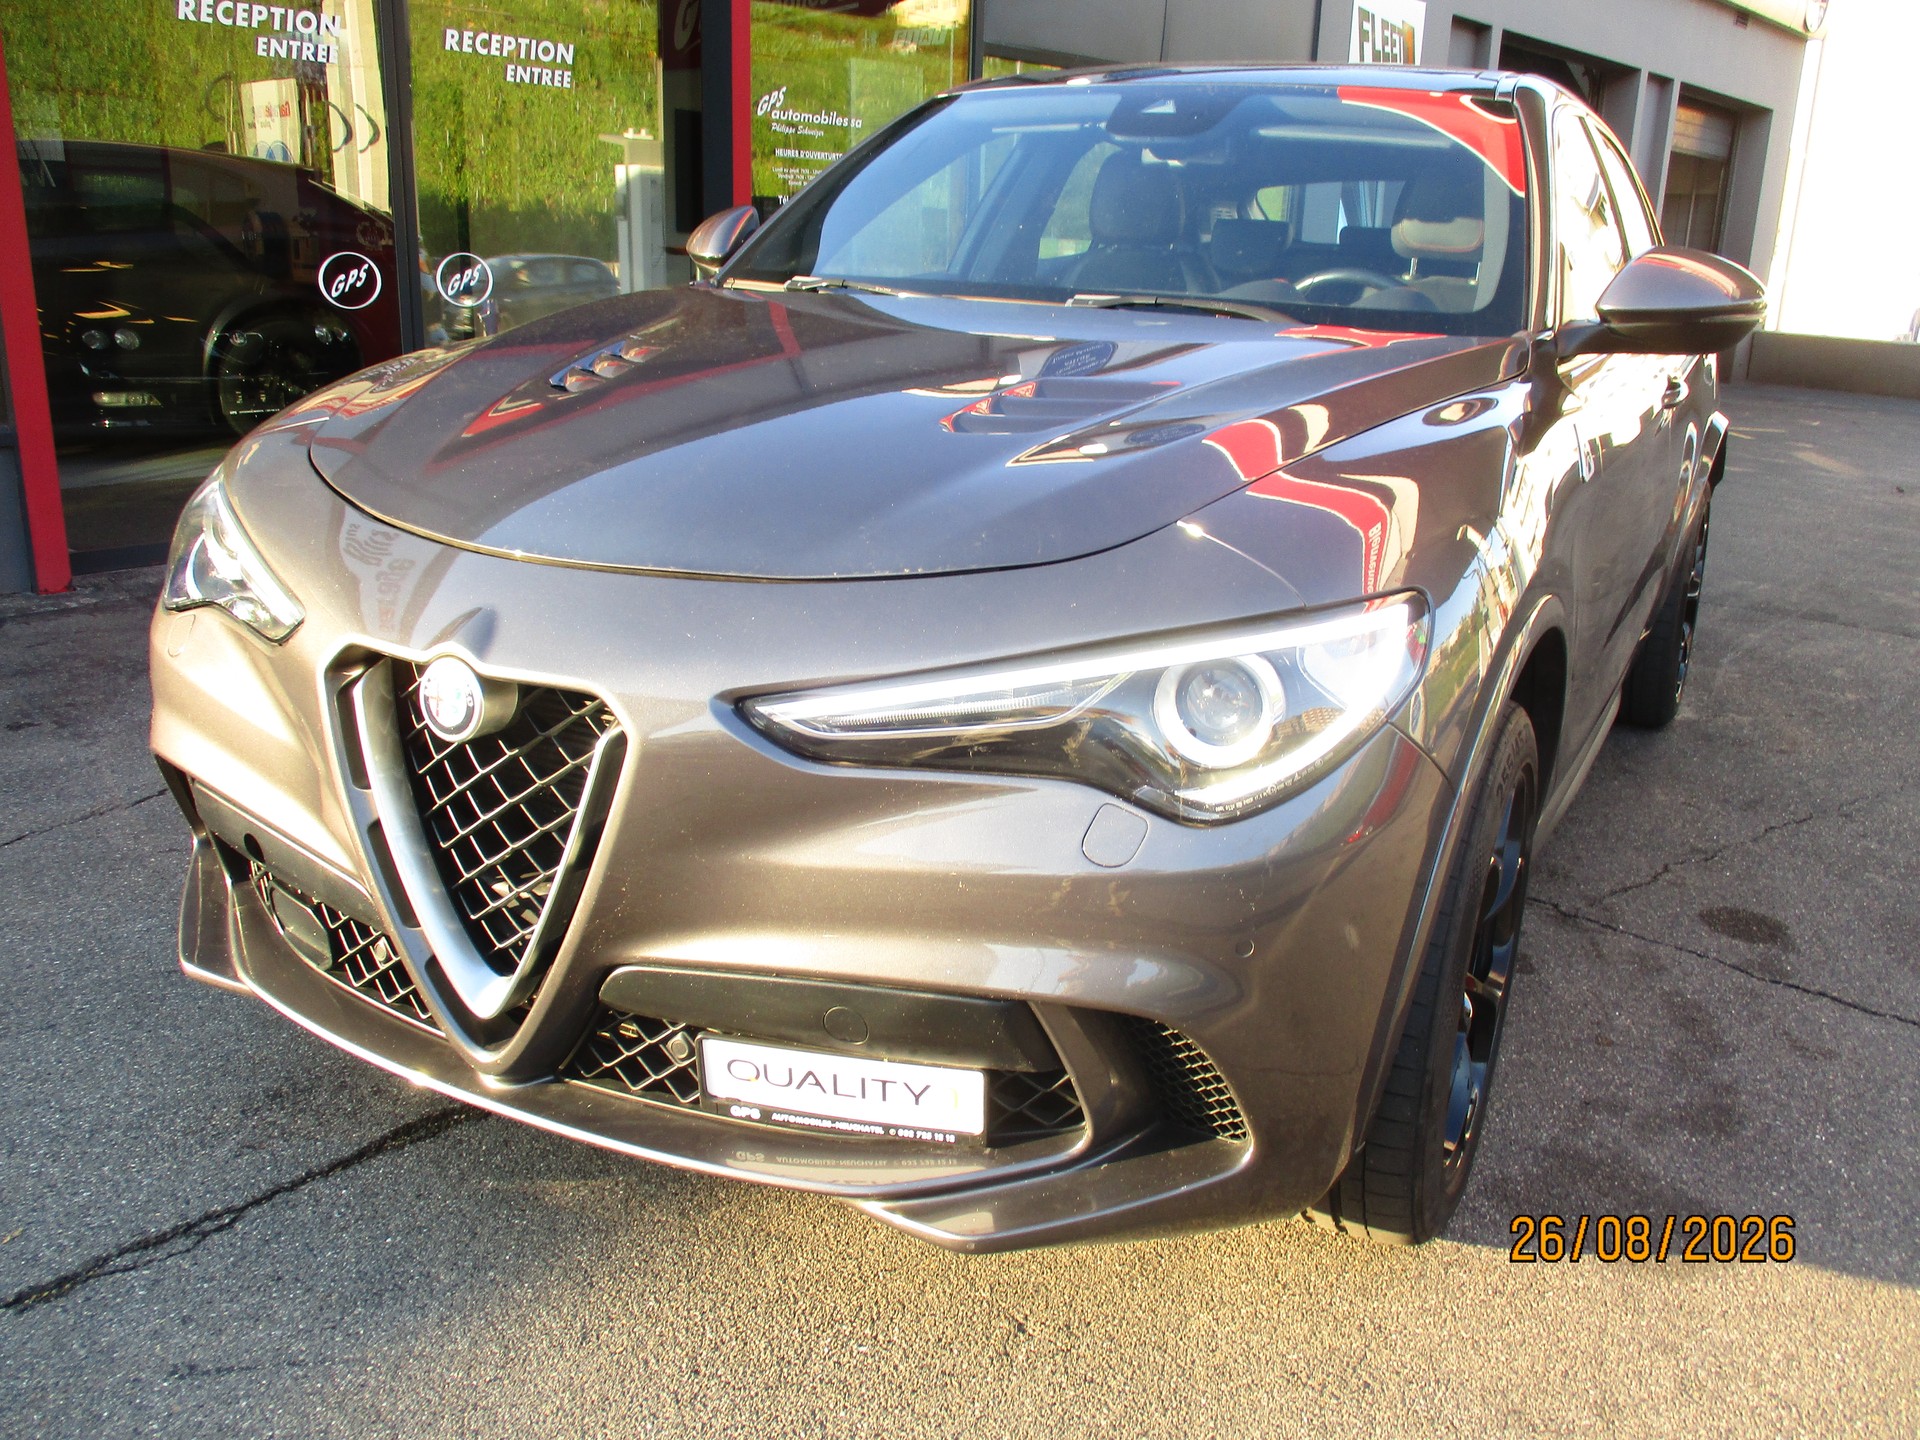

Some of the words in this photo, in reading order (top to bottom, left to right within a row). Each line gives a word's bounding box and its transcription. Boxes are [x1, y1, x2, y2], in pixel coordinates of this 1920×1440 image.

[177, 0, 341, 37] RECEPTION
[256, 36, 339, 64] ENTREE
[444, 28, 574, 65] RECEPTION
[506, 64, 572, 88] ENTREE
[757, 86, 787, 117] GPS
[771, 109, 849, 127] automobiles
[850, 119, 863, 129] sa
[775, 147, 799, 158] HEURES
[331, 263, 369, 298] GPS
[447, 263, 482, 296] GPS
[727, 1058, 931, 1106] QUALITY
